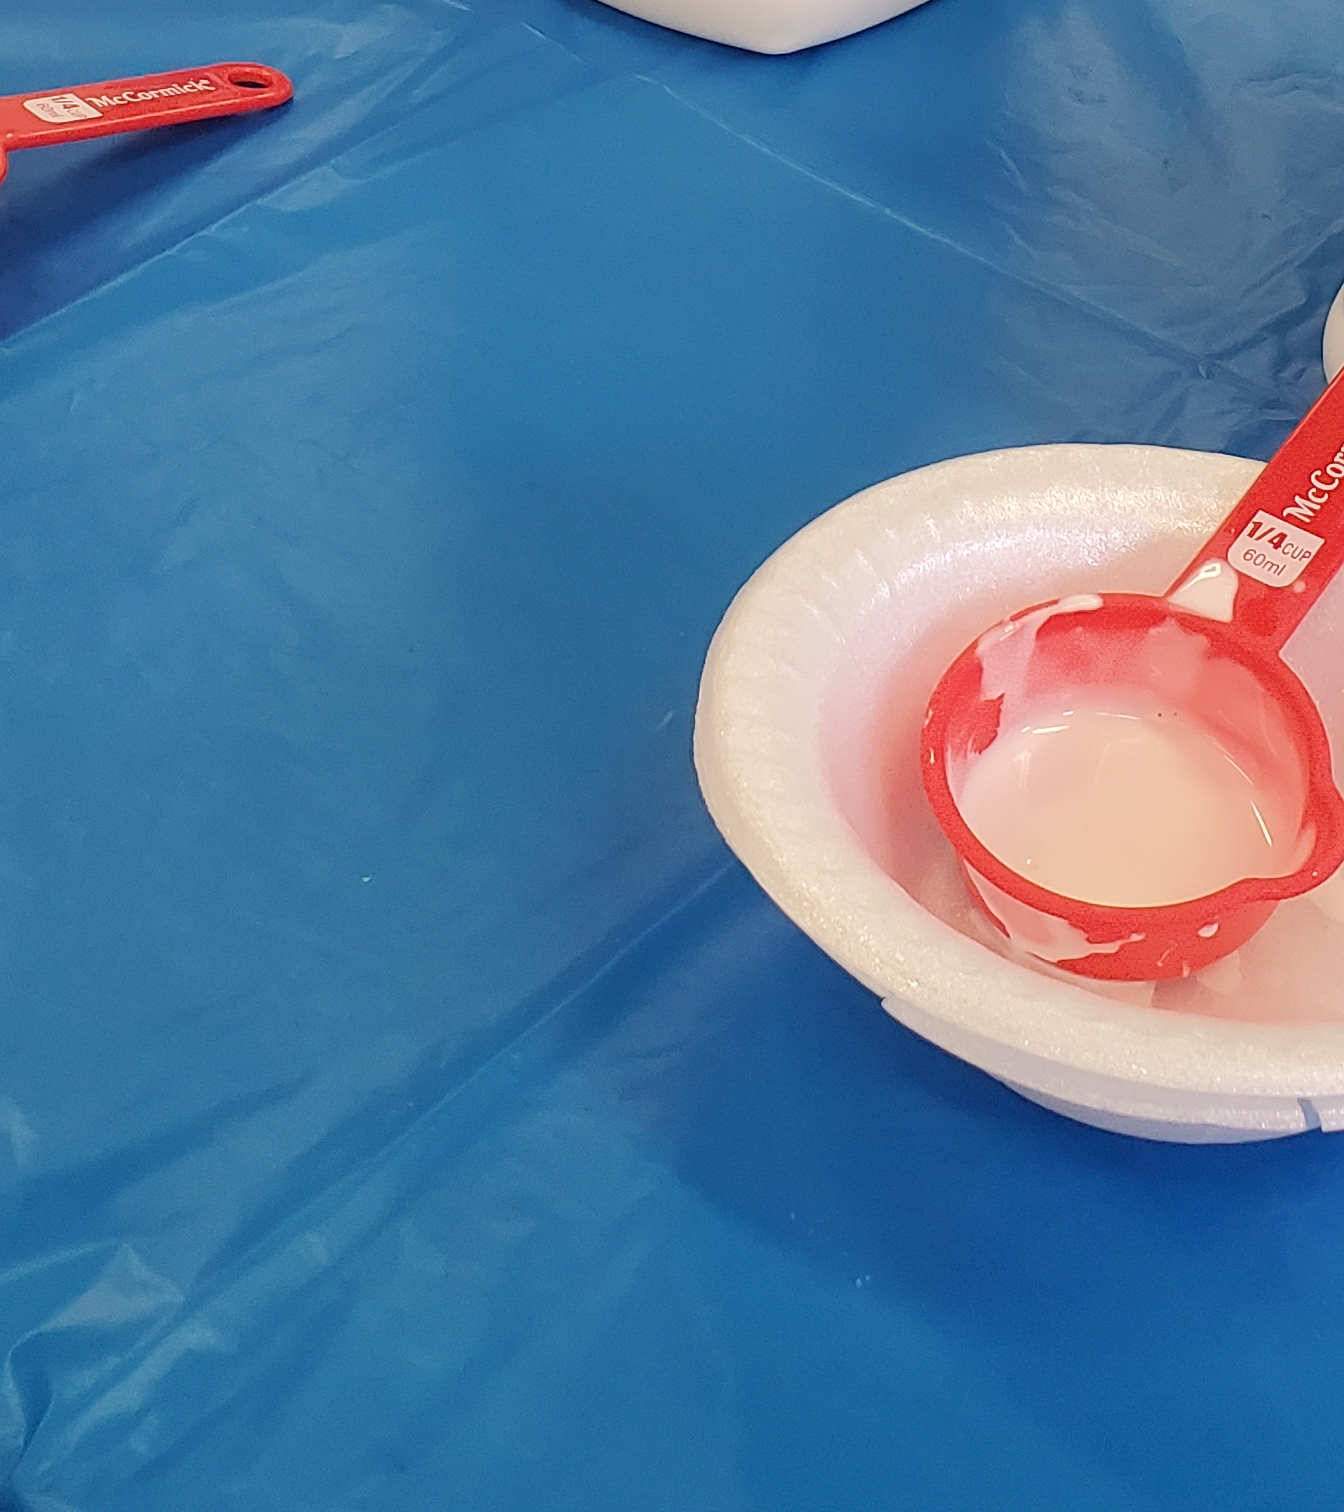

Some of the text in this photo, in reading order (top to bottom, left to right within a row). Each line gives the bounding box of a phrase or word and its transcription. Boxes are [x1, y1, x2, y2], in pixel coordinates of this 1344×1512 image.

[86, 77, 216, 108] McCormick
[1245, 521, 1312, 563] 1/4 CUP
[1243, 548, 1286, 577] 60ml
